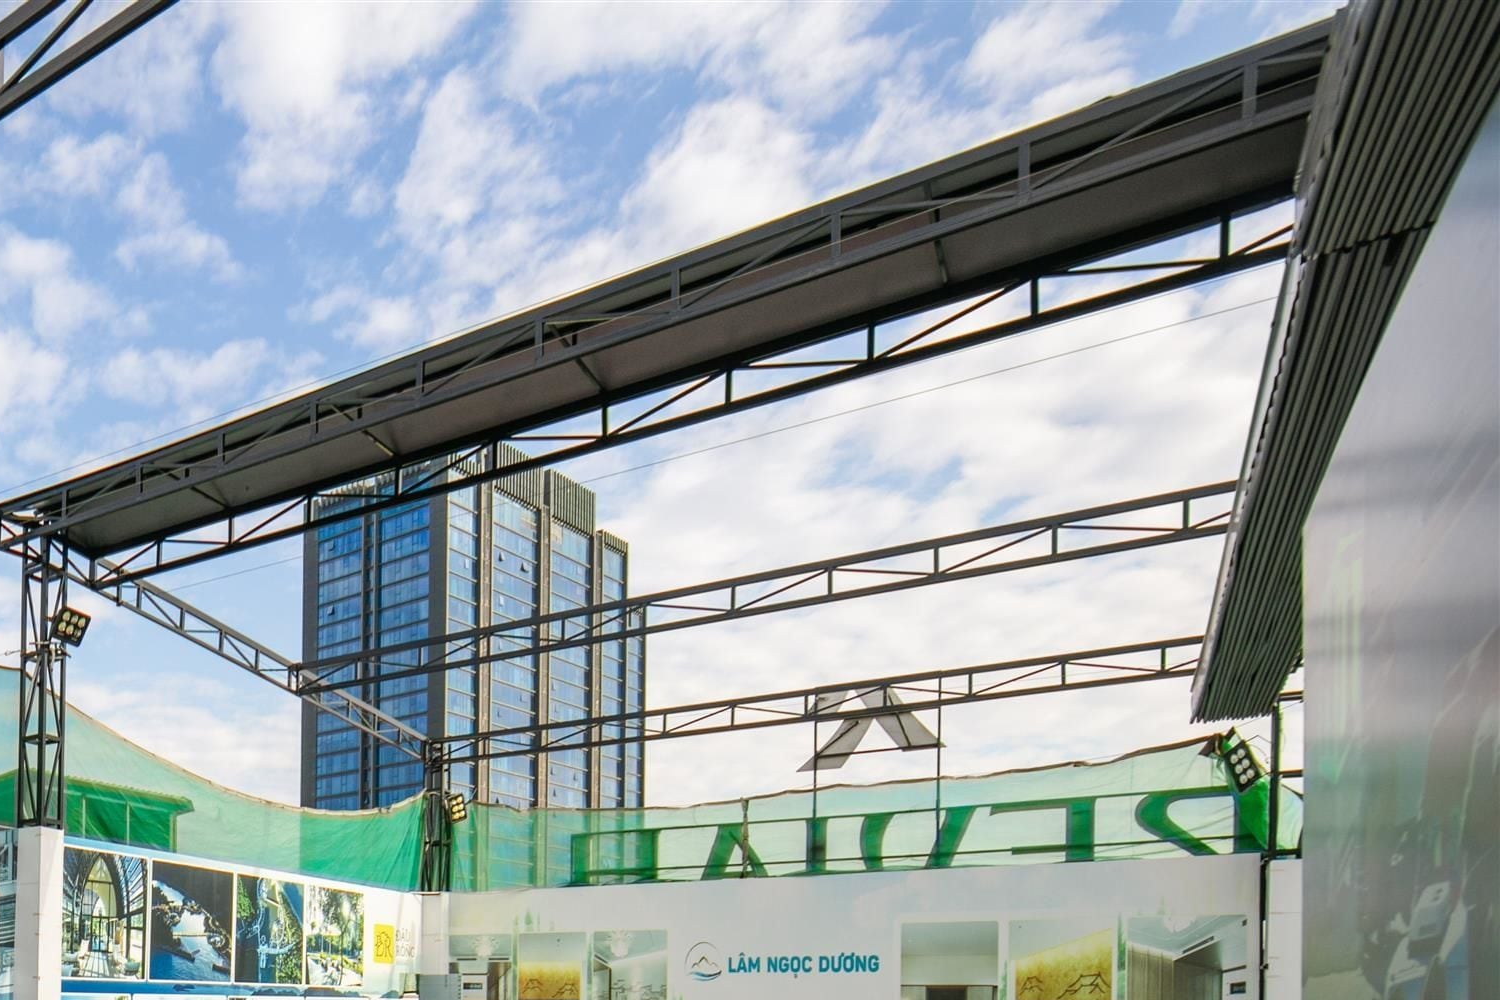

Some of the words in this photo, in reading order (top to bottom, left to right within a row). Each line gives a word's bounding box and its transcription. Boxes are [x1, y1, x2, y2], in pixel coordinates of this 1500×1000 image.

[728, 952, 761, 973] LÂM
[767, 956, 813, 978] NGỌC
[819, 952, 880, 973] DƯƠNG
